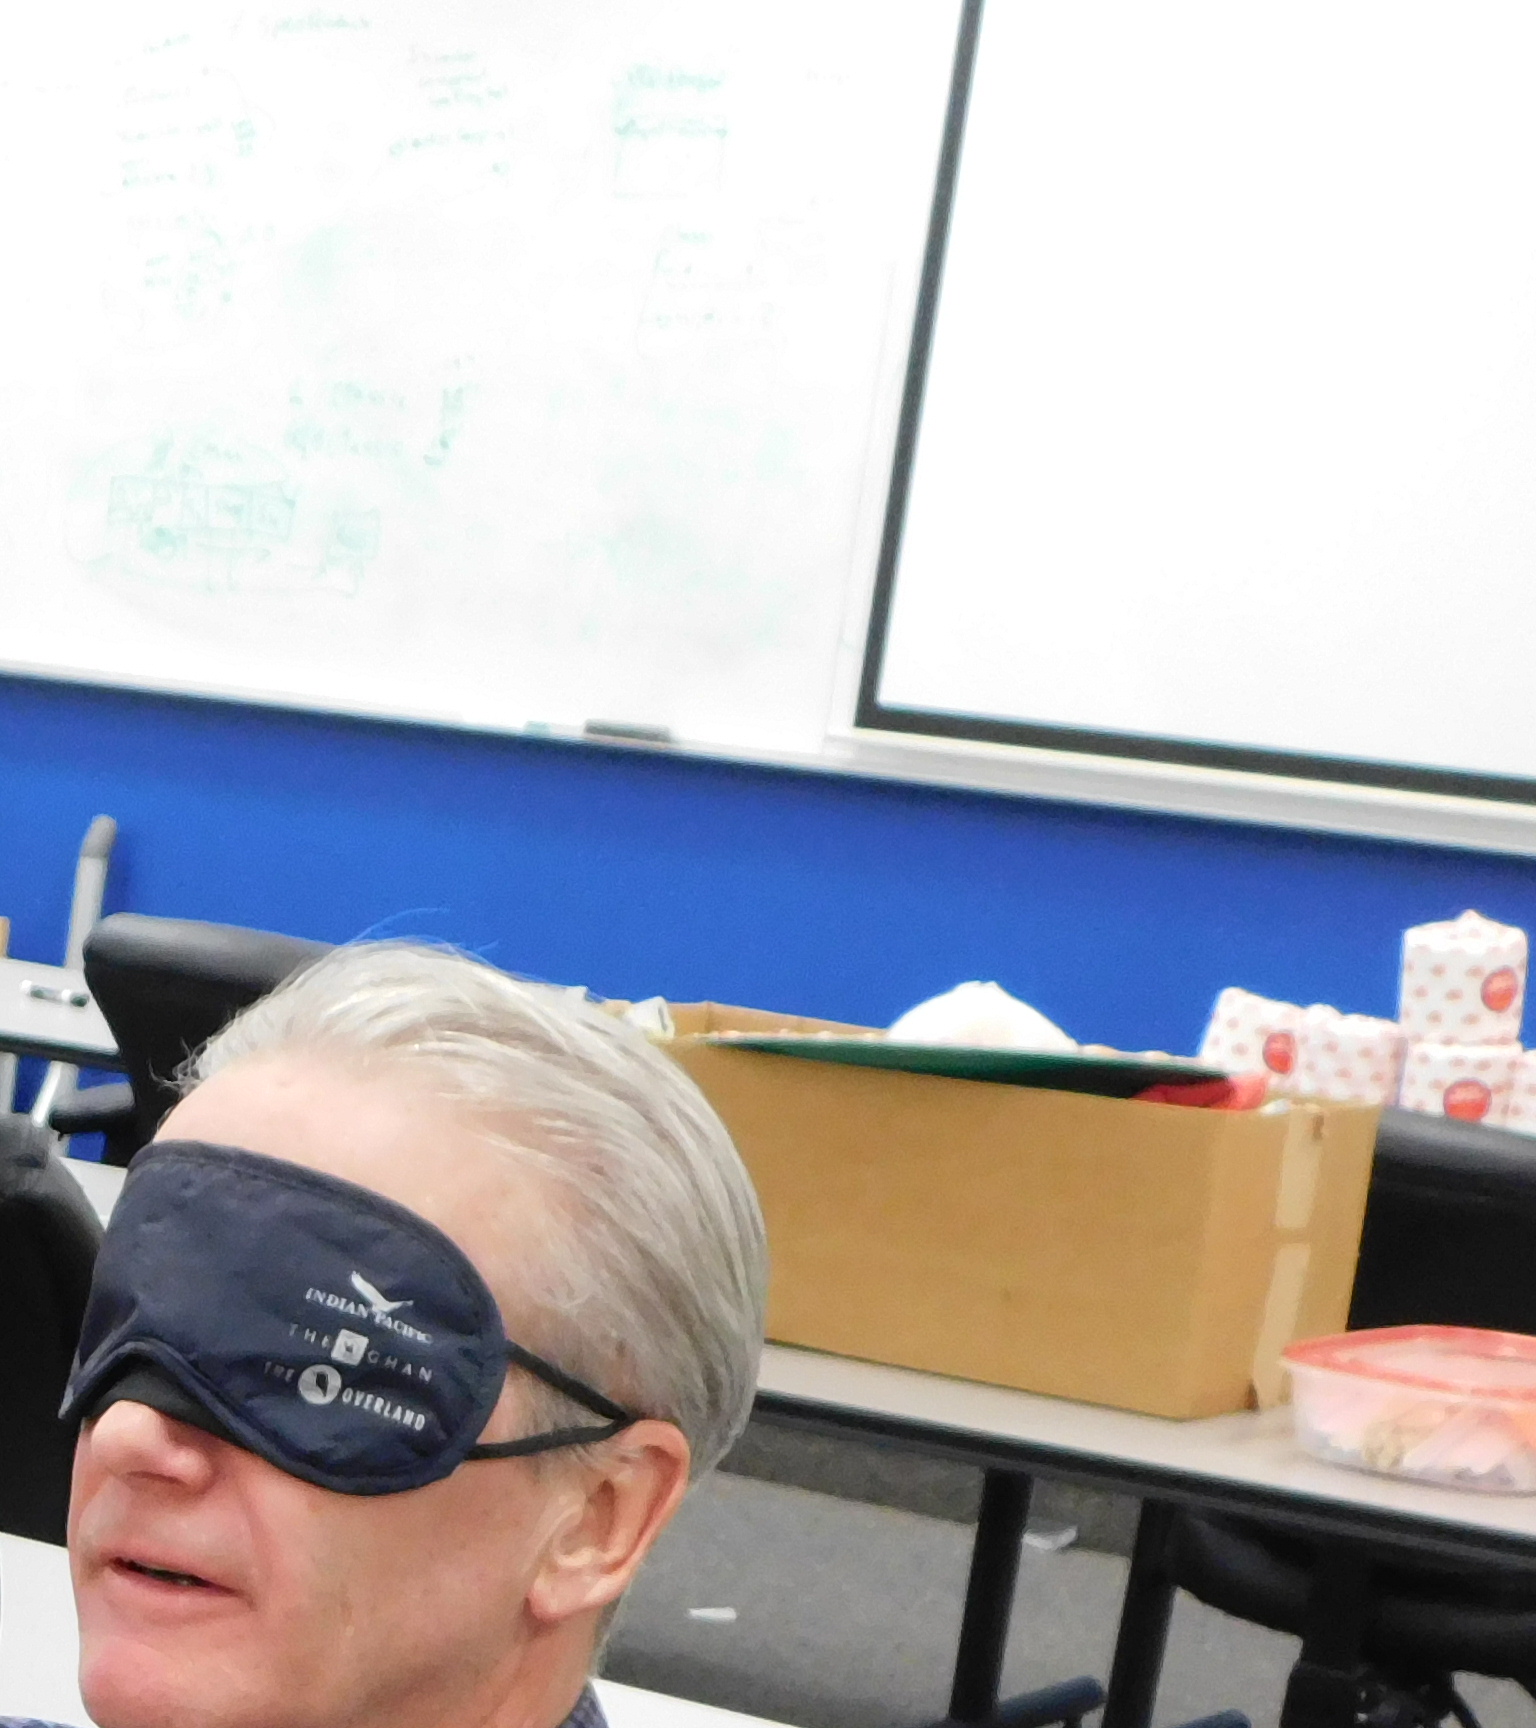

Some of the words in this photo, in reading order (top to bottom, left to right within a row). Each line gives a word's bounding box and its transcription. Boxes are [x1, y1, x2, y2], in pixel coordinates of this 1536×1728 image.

[304, 1287, 369, 1320] INDIAN
[374, 1309, 433, 1345] PACIFIC
[289, 1323, 332, 1350] THE
[366, 1350, 434, 1383] GHAN
[341, 1388, 426, 1432] OVERLAND
